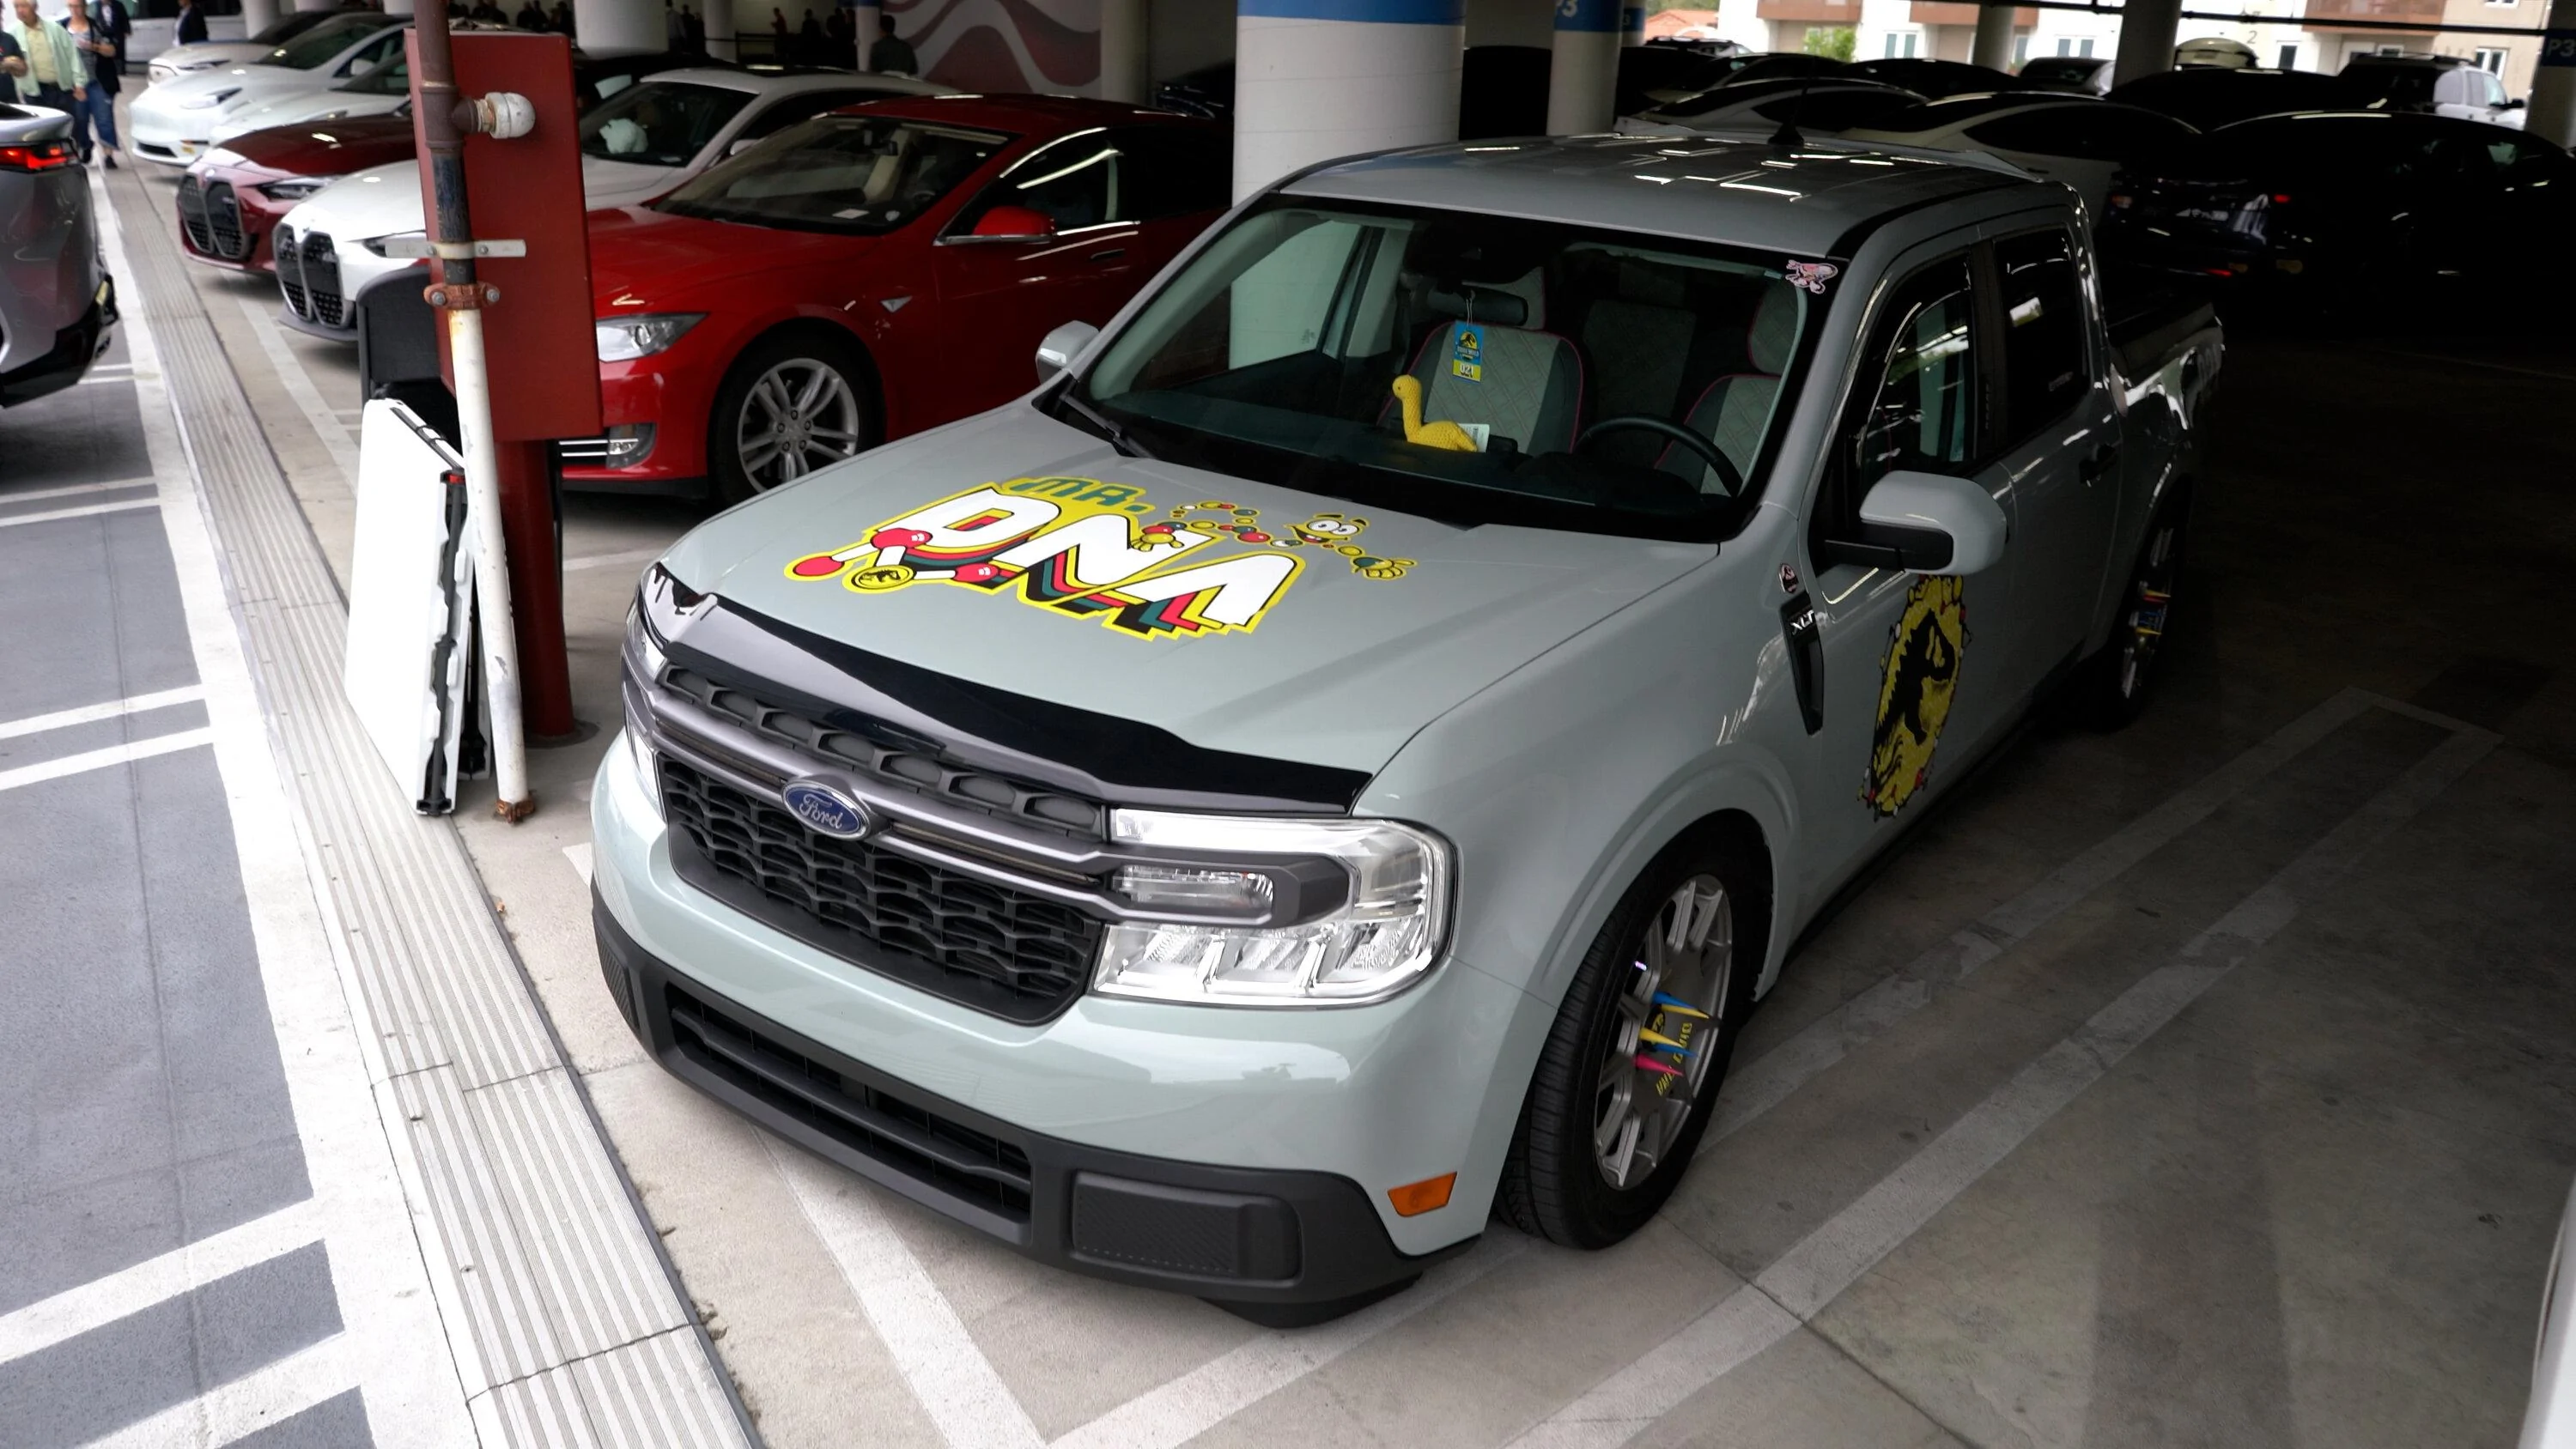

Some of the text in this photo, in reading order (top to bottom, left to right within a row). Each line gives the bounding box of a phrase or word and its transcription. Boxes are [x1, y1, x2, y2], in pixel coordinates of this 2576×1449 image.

[2246, 30, 2258, 45] 2
[2546, 38, 2576, 57] P3
[1009, 477, 1148, 512] MR.
[874, 488, 1297, 627] DNA
[1789, 609, 1814, 635] XLT
[799, 792, 843, 830] Ford
